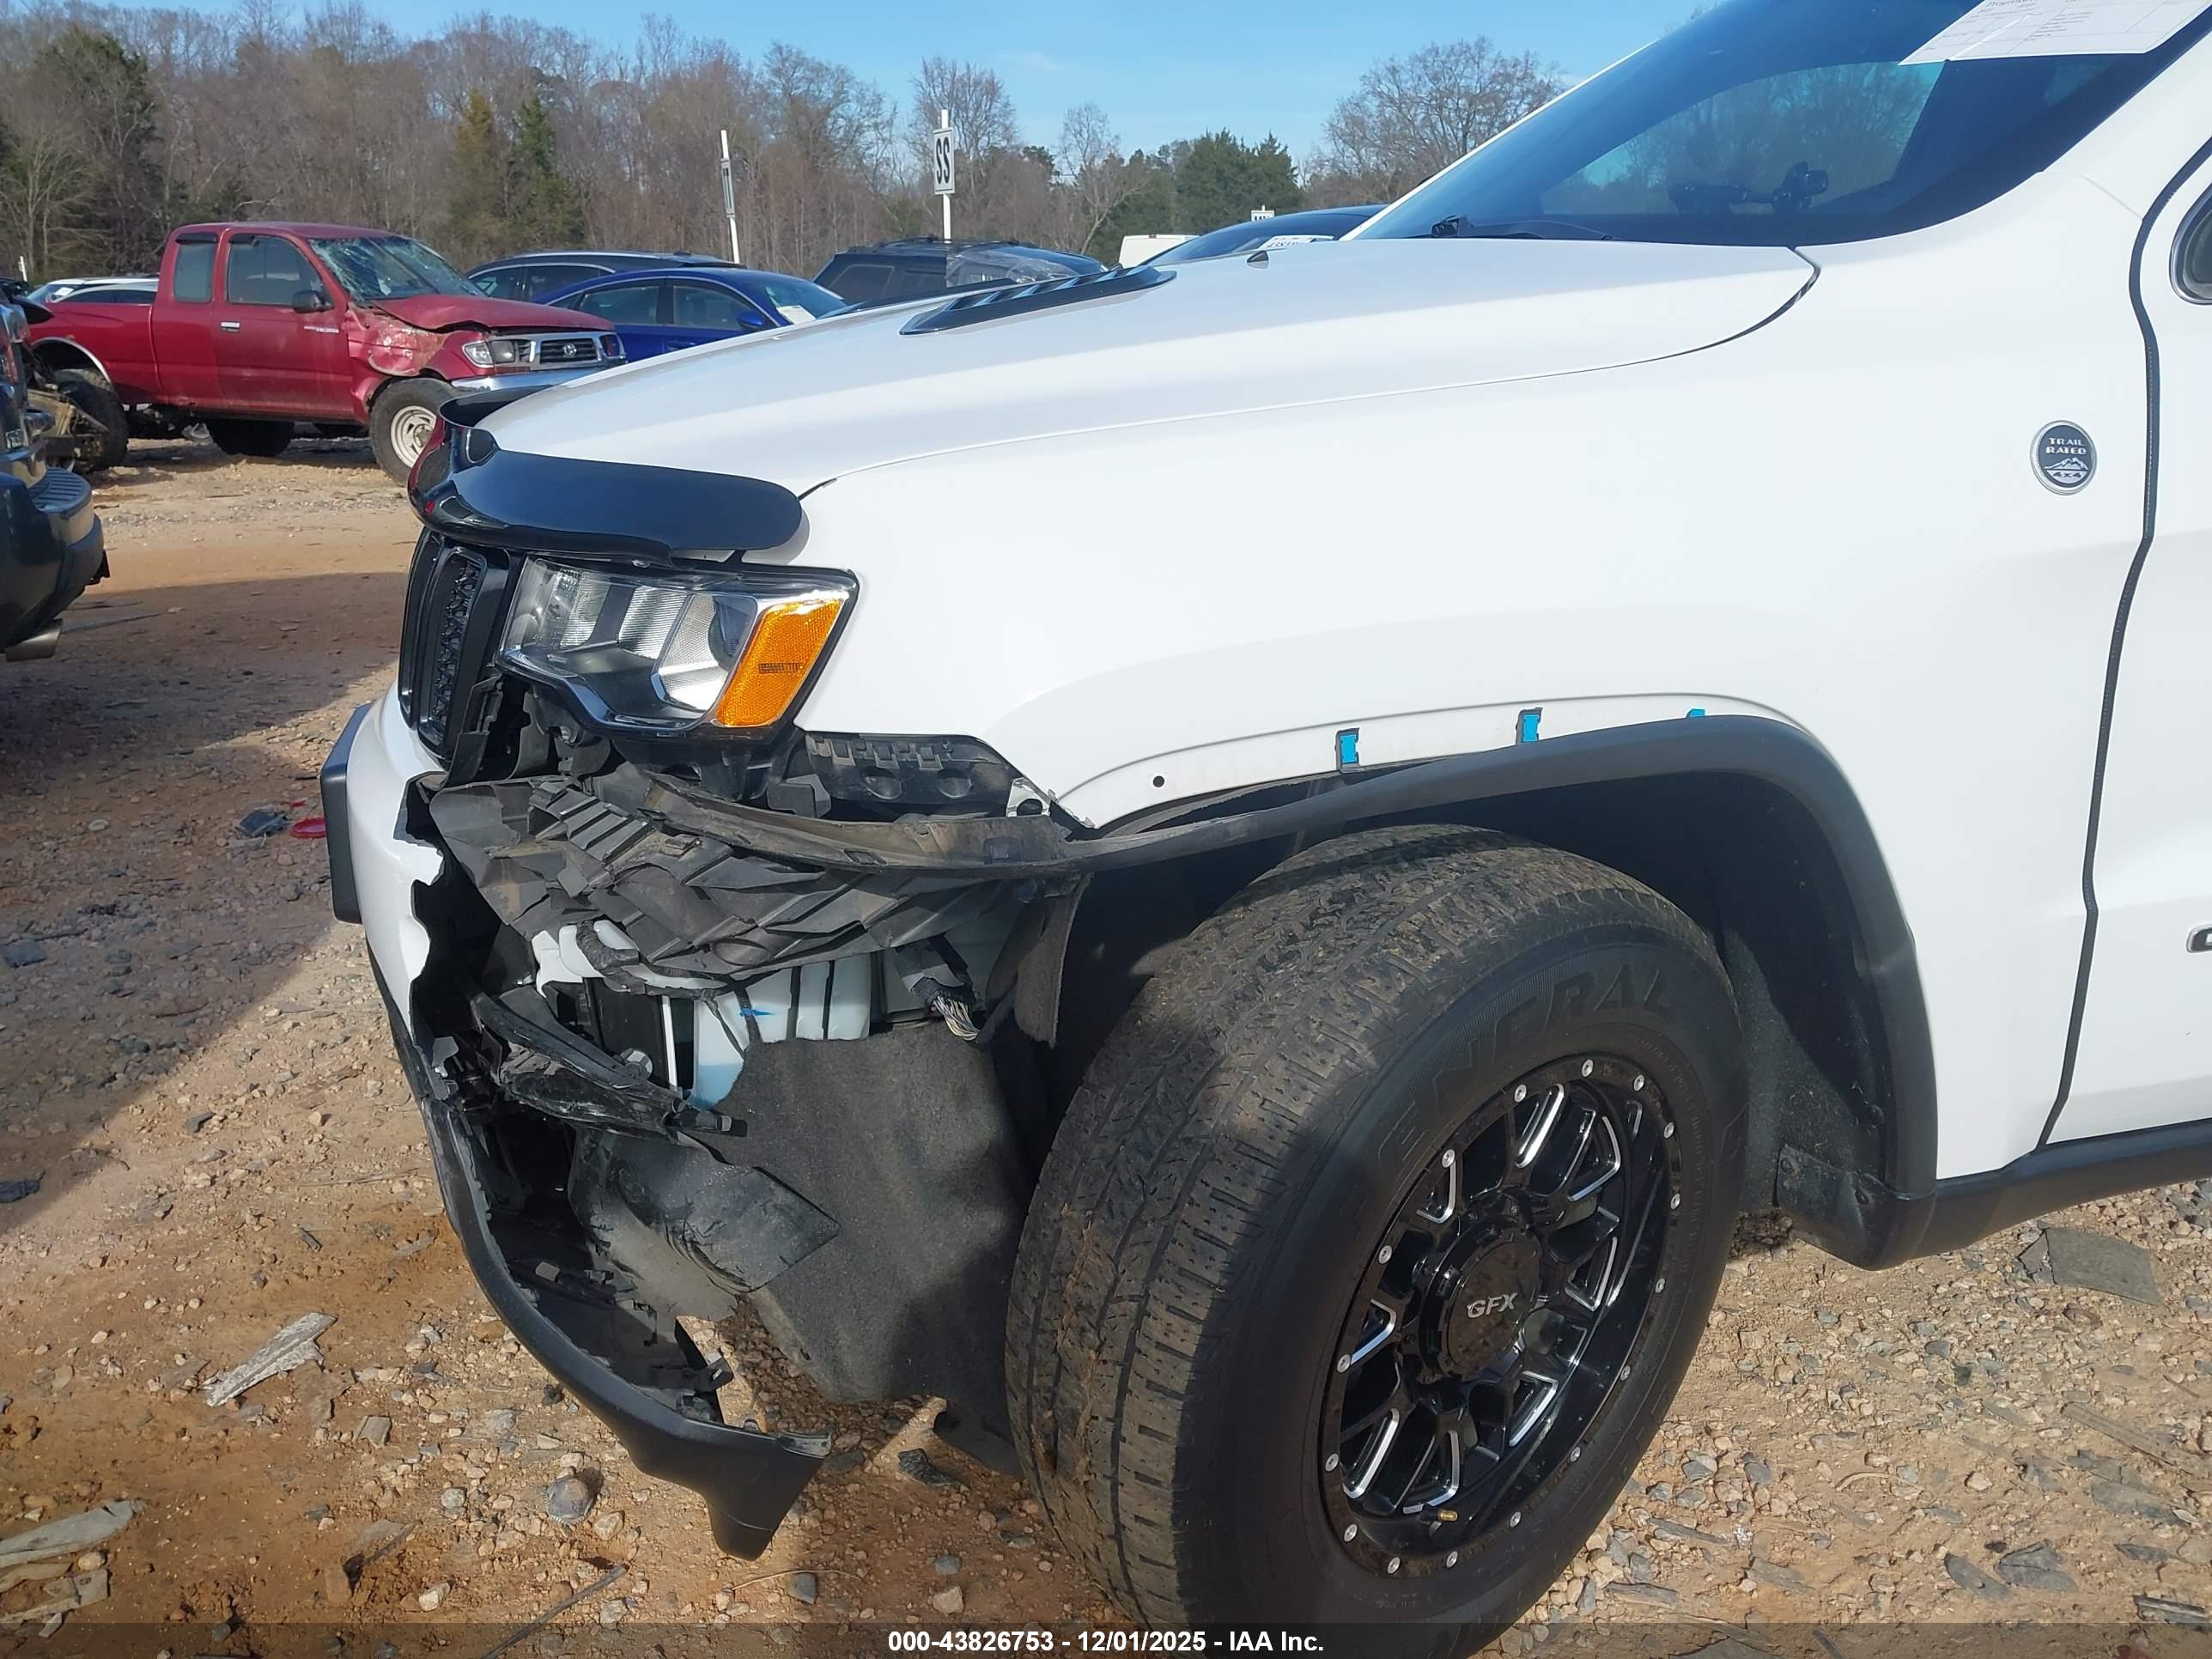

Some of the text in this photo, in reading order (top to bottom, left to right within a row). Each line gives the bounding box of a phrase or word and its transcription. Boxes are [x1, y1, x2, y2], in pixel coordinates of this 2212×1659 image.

[935, 136, 951, 185] SS
[2045, 446, 2087, 455] RATED
[2048, 437, 2086, 447] TRAIL
[1467, 1292, 1518, 1318] GFX
